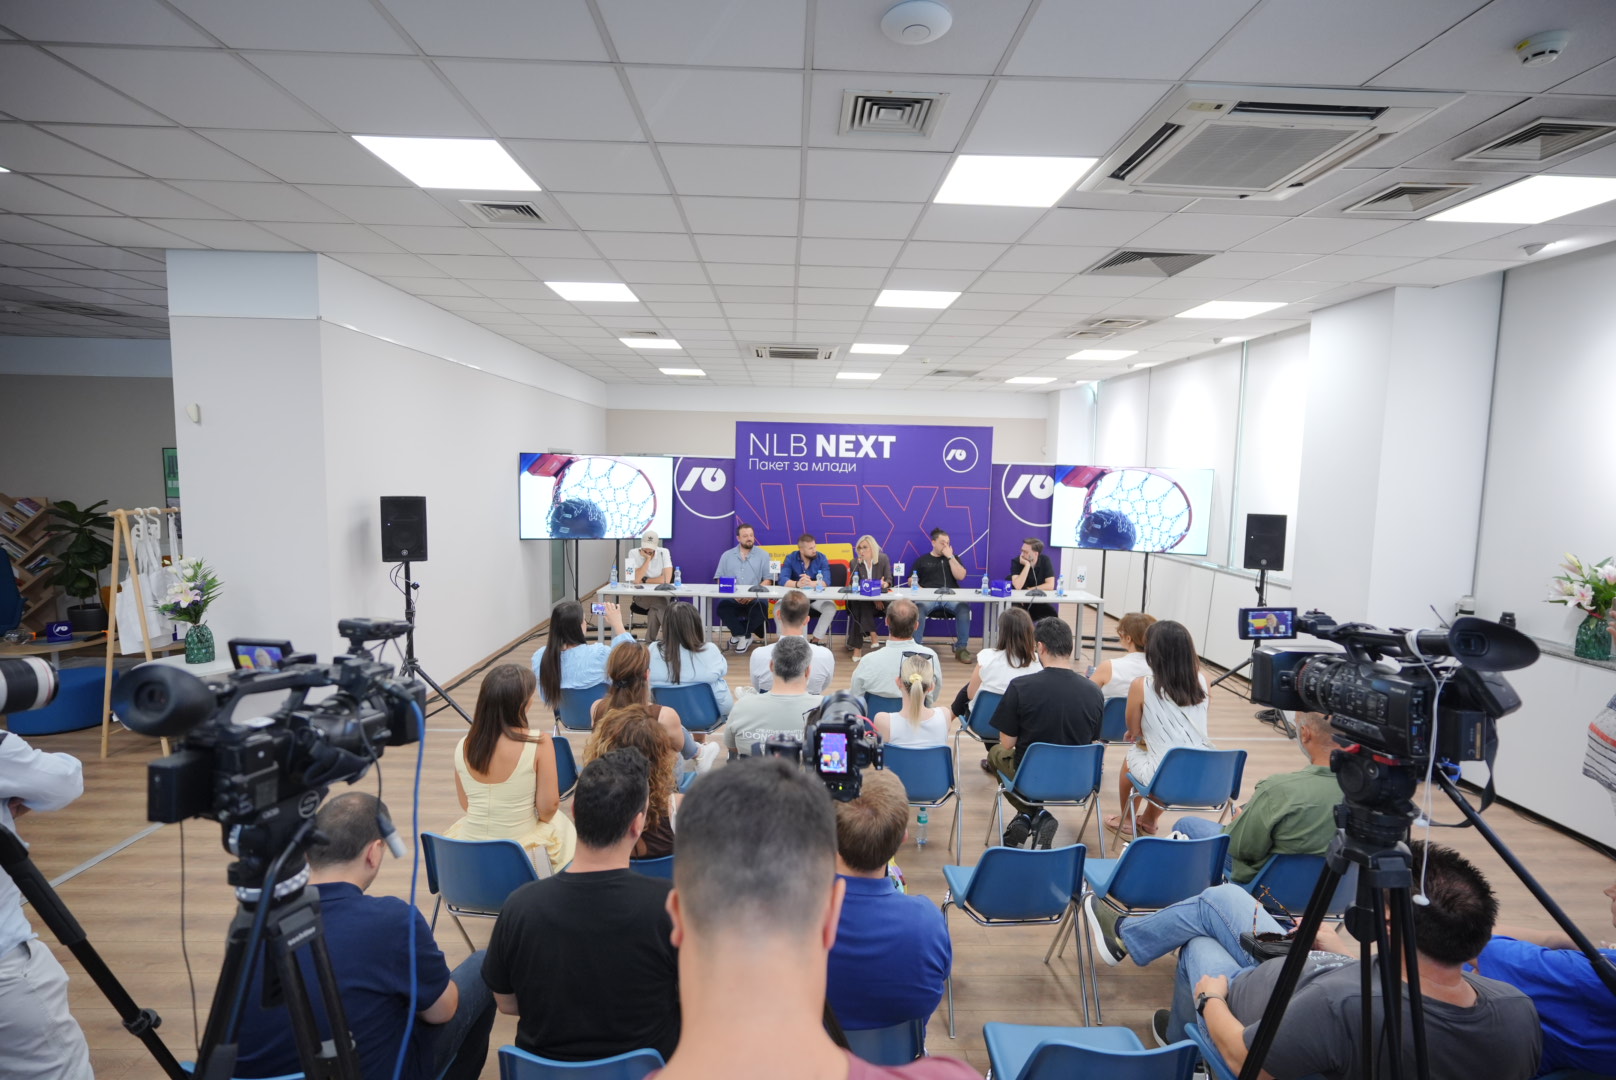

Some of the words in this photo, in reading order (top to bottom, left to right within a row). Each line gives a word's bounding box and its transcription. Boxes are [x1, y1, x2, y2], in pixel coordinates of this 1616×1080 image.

[749, 432, 807, 457] NLB
[815, 434, 897, 459] NEXT
[749, 458, 791, 471] Пакет
[793, 461, 808, 472] за
[811, 462, 857, 473] млади
